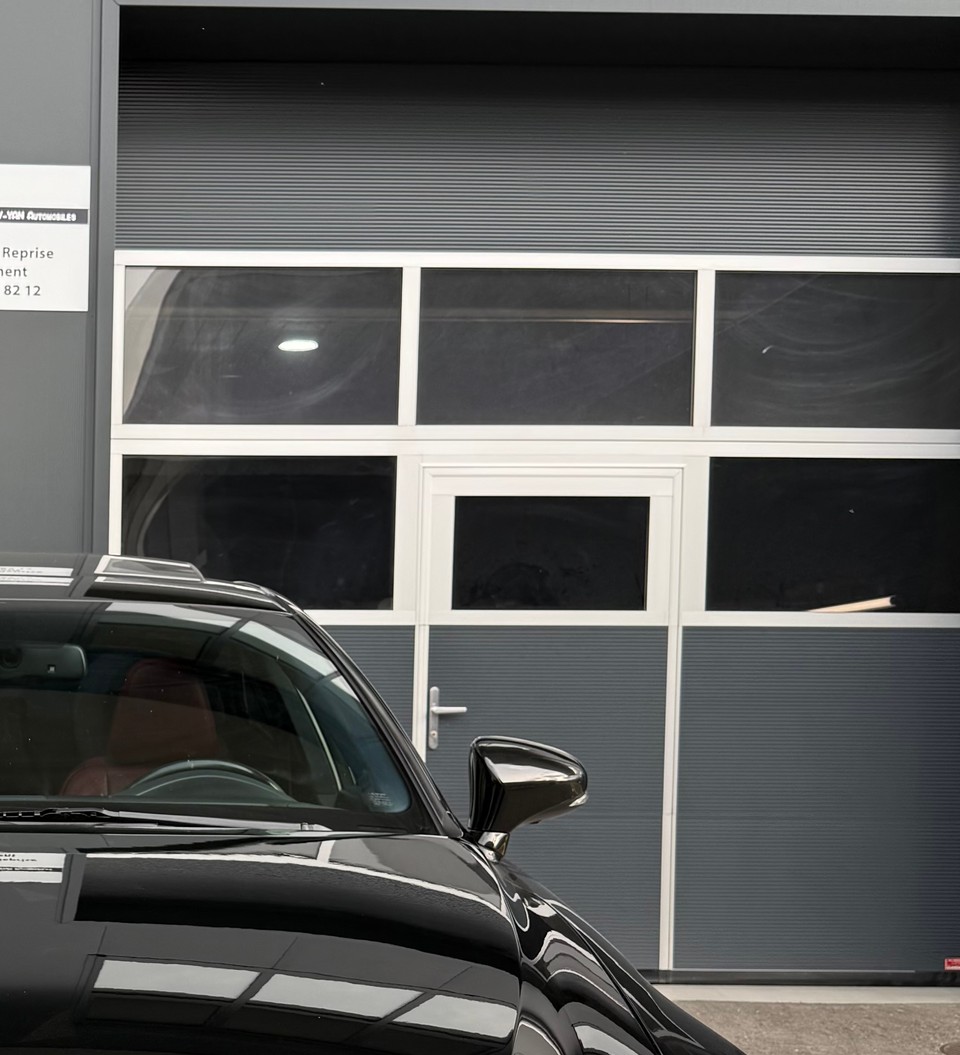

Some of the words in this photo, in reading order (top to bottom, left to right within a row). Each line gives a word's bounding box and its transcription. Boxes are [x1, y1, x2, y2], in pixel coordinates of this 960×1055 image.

[2, 247, 54, 261] Reprise
[4, 285, 20, 296] 82
[26, 285, 41, 297] 12
